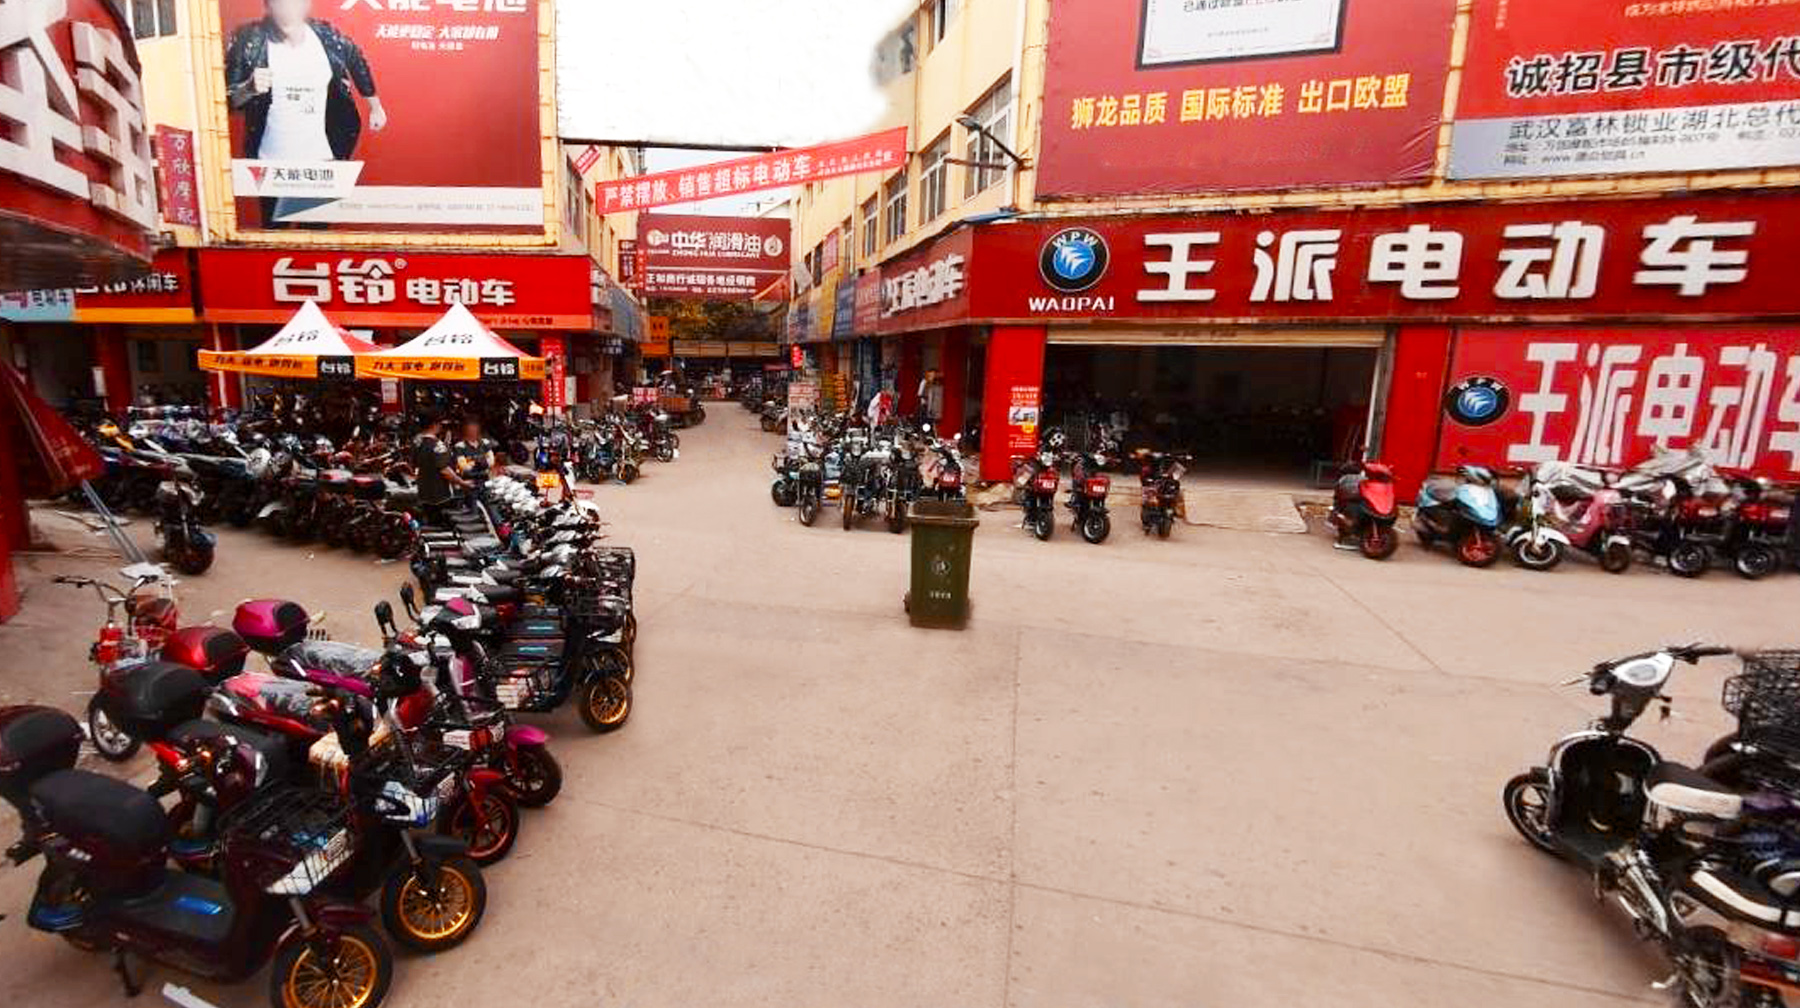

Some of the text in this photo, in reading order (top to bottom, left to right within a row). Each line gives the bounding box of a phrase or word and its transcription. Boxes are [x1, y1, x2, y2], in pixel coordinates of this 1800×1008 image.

[1071, 73, 1411, 129] 狮龙品质 国际标准 出口欧盟
[272, 168, 334, 181] 天能电池
[603, 153, 812, 209] 严禁摆放、销售超标电动车
[671, 230, 761, 252] 中华润滑油
[1052, 231, 1099, 247] WPW
[1137, 214, 1758, 302] 王派电动车
[406, 276, 516, 306] 电动车
